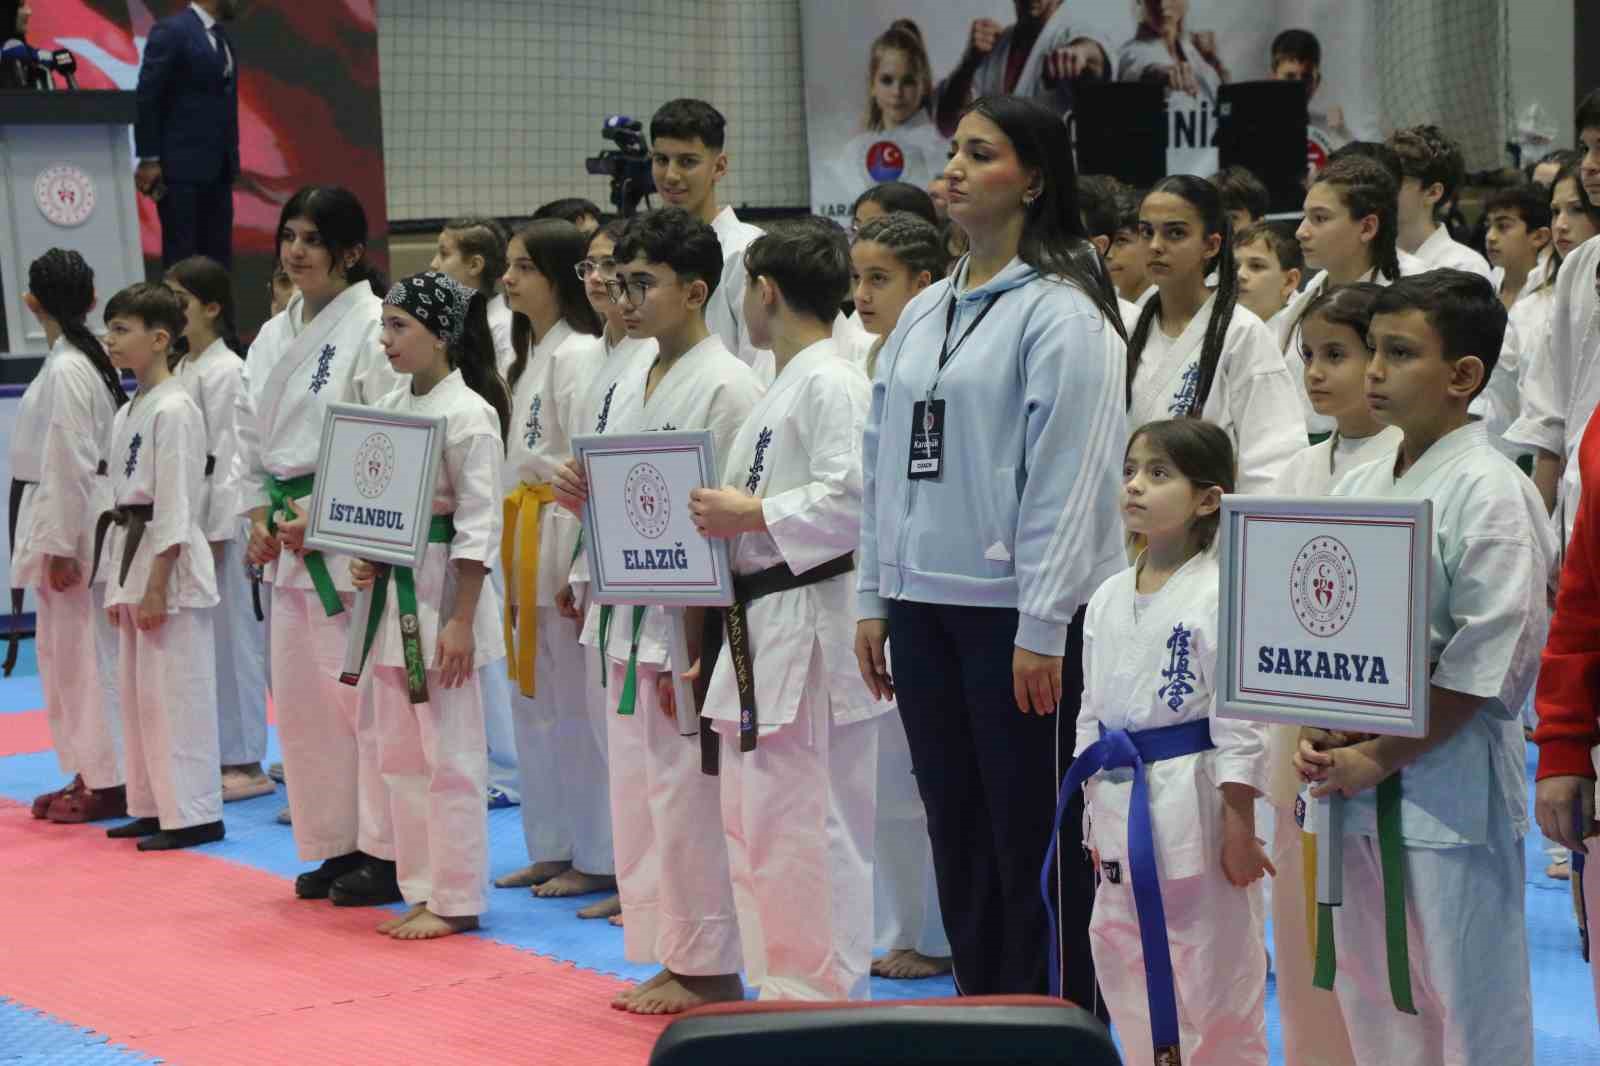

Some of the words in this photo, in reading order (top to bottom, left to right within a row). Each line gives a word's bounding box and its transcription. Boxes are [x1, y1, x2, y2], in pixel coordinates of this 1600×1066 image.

[329, 498, 405, 531] İSTANBUL
[623, 541, 689, 570] ELAZIĞ
[1257, 645, 1390, 685] SAKARYA
